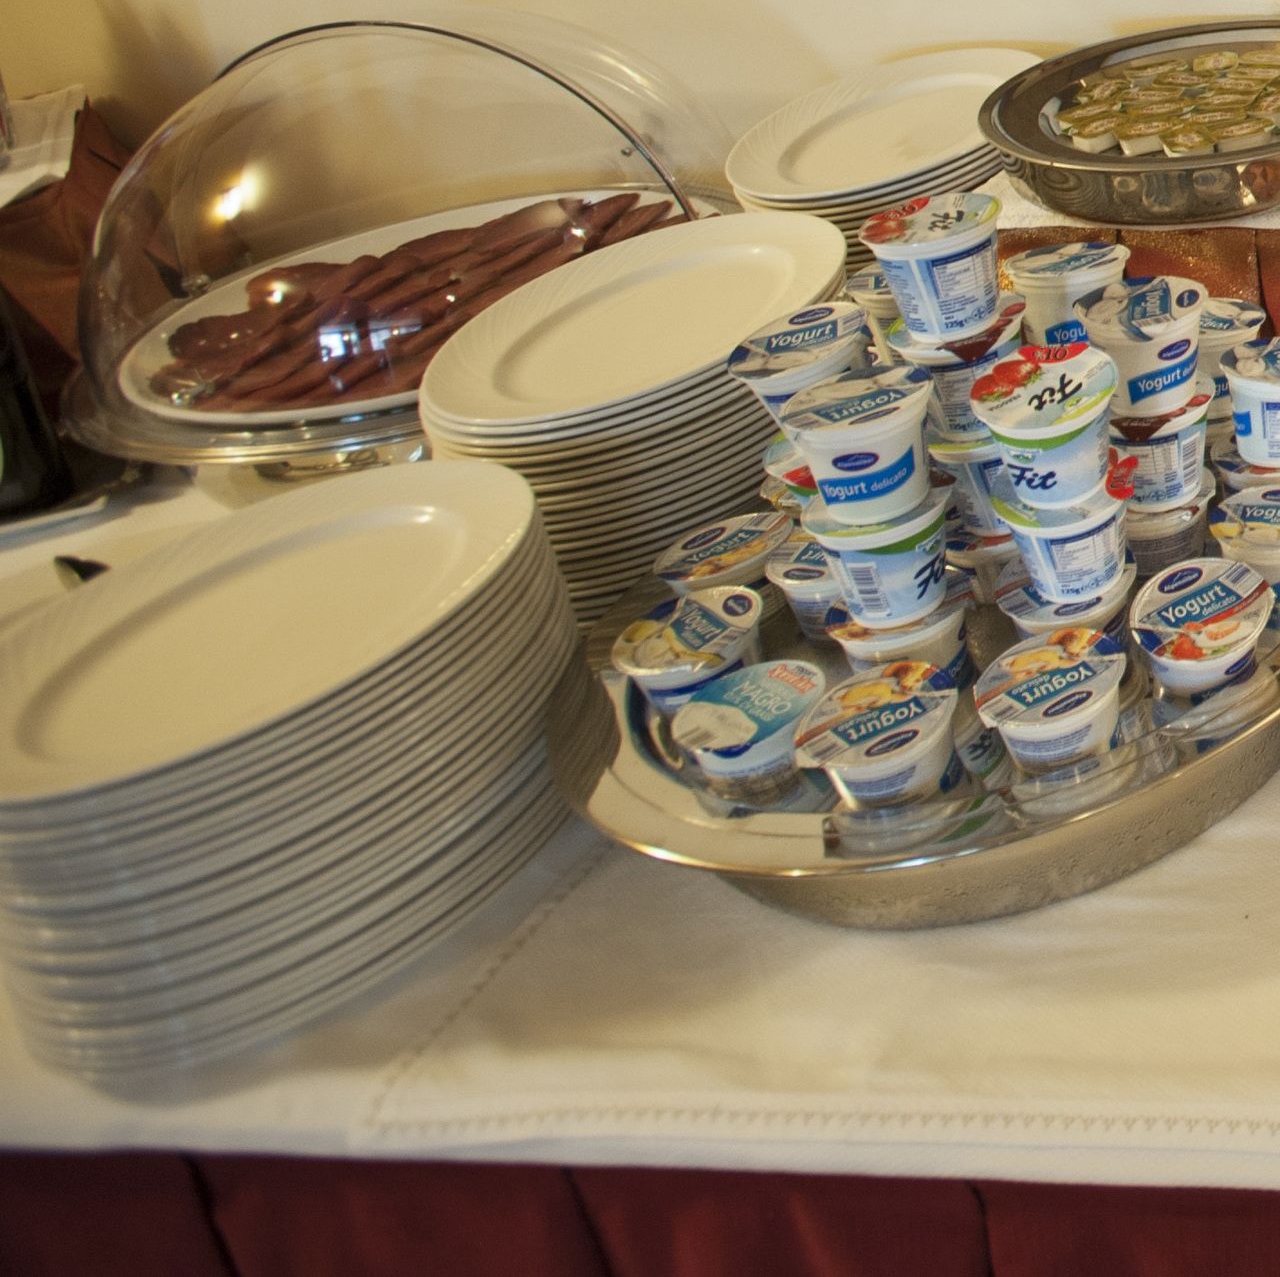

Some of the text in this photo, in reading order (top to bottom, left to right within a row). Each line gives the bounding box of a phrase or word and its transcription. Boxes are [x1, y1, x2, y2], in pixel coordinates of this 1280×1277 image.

[770, 324, 833, 349] Yogurt
[1138, 367, 1181, 393] Yogurt
[829, 391, 902, 420] Yogurt
[822, 480, 867, 500] Yogurt
[1006, 463, 1058, 490] Fit
[1161, 584, 1227, 623] Yogurt
[1201, 595, 1237, 617] delicato
[730, 681, 793, 715] MAGRO
[1022, 666, 1094, 704] Yogurt
[845, 701, 923, 741] Yogurt
